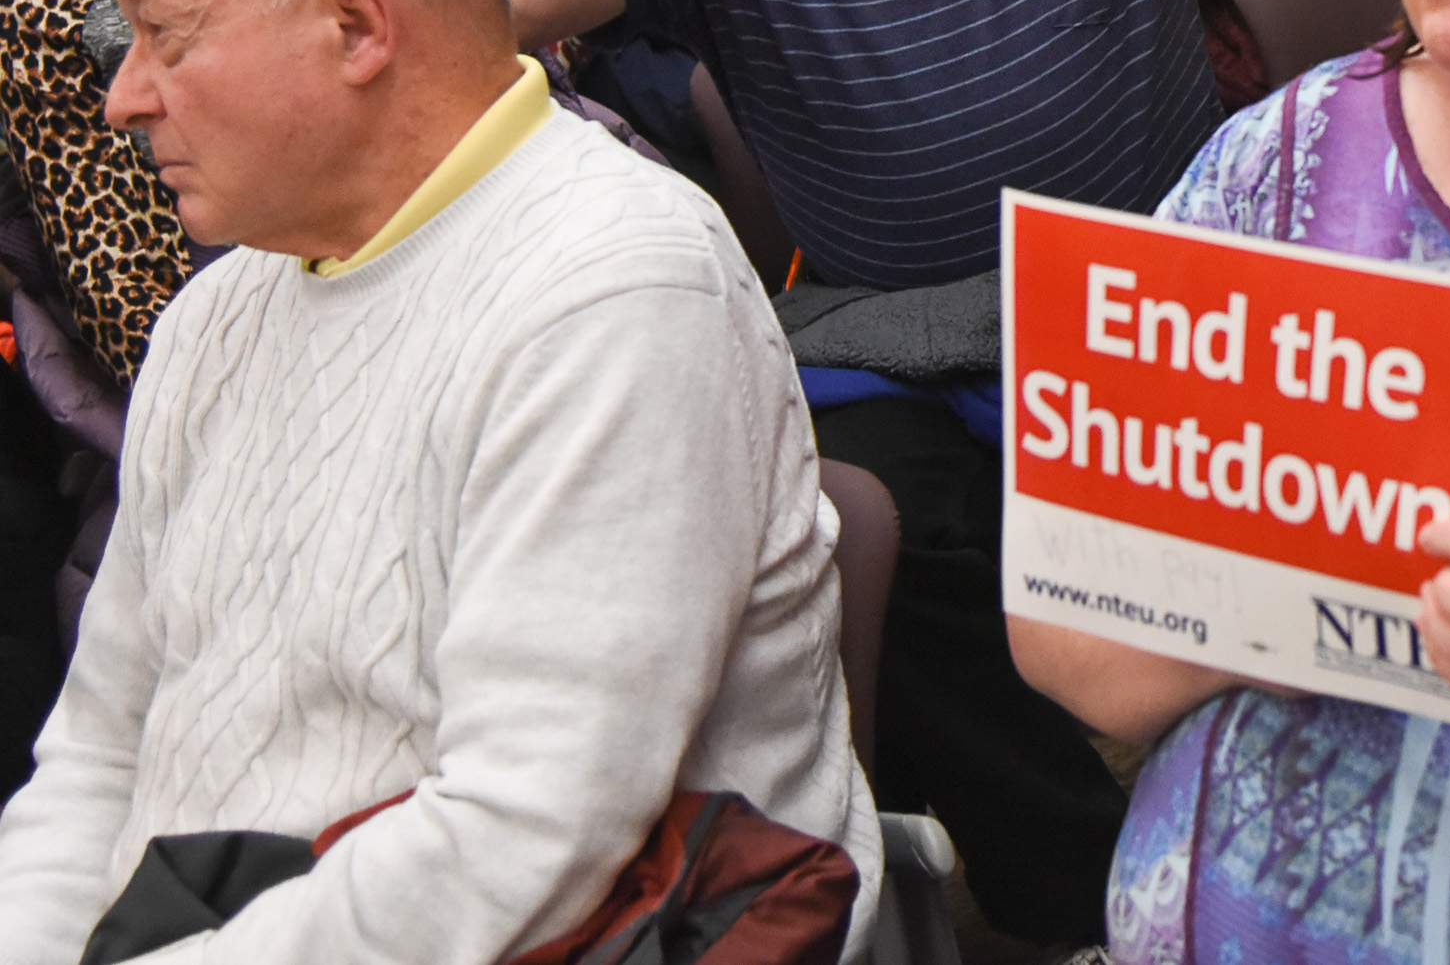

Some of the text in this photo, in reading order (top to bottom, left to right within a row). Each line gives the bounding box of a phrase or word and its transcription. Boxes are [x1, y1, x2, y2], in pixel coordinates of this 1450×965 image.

[1085, 262, 1426, 420] End the
[1023, 573, 1208, 645] www.nteu.org
